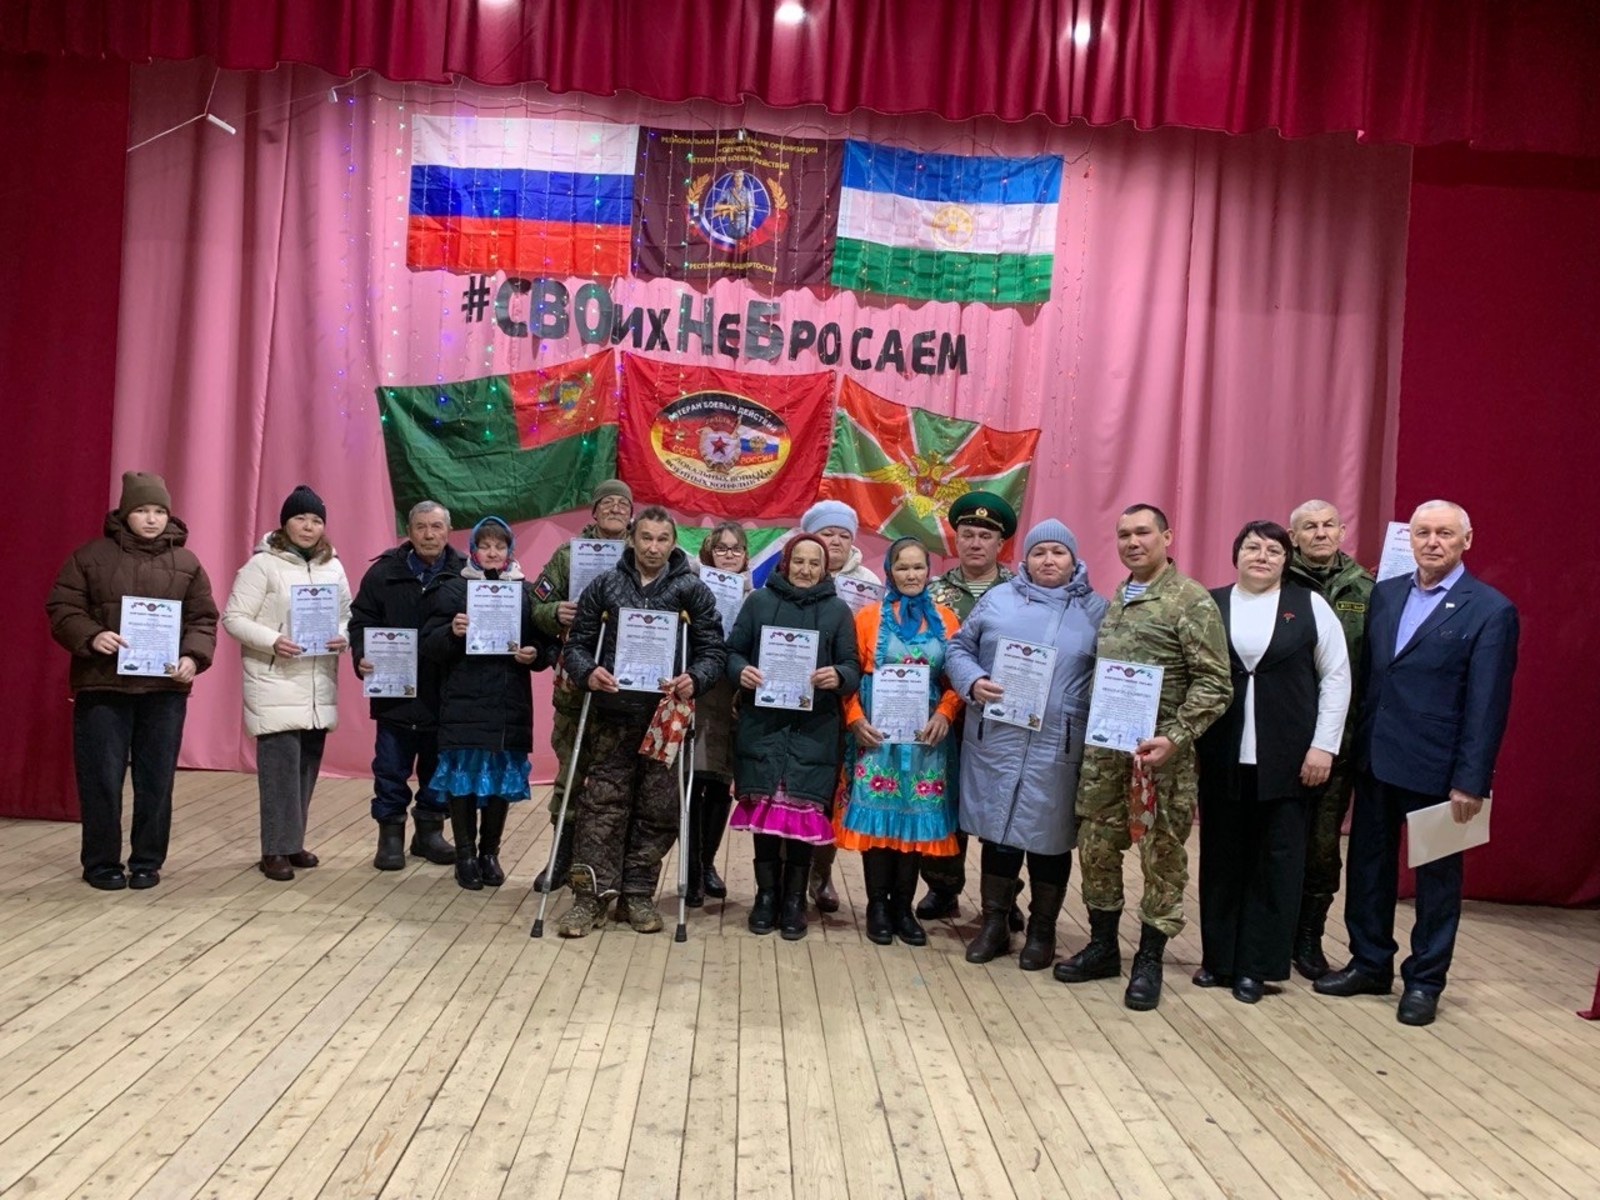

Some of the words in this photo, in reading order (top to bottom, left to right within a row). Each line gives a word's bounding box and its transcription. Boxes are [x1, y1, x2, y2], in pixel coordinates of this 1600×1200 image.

[703, 400, 737, 412] БОЕВЫХ
[672, 444, 698, 457] СССР
[740, 454, 774, 465] РОССИЯ
